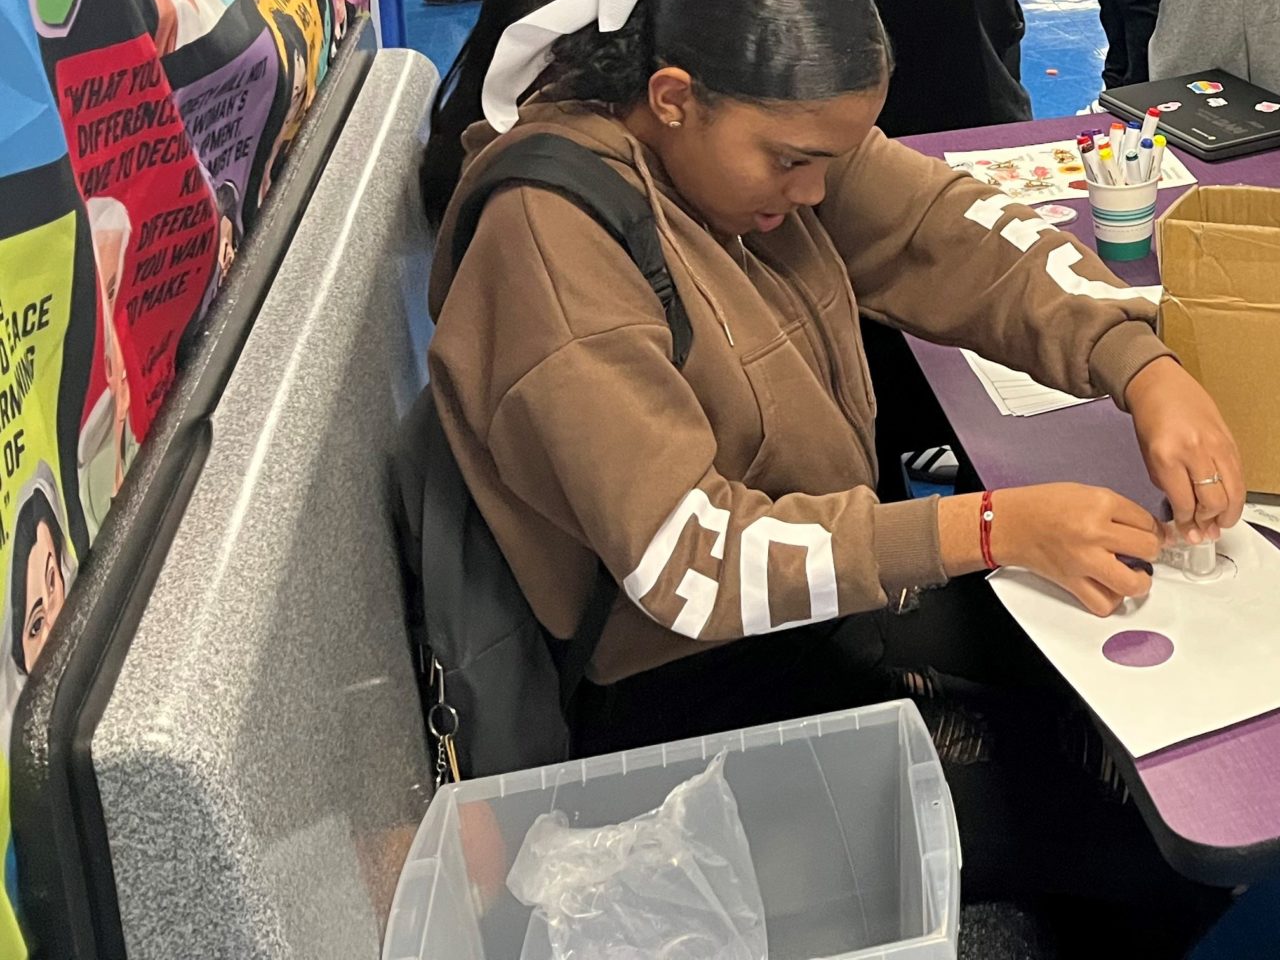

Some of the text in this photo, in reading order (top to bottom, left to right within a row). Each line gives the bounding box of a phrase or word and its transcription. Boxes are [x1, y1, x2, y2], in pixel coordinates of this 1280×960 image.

[128, 58, 161, 95] YOU
[132, 225, 215, 286] YOU WANT
[4, 428, 26, 478] OF
